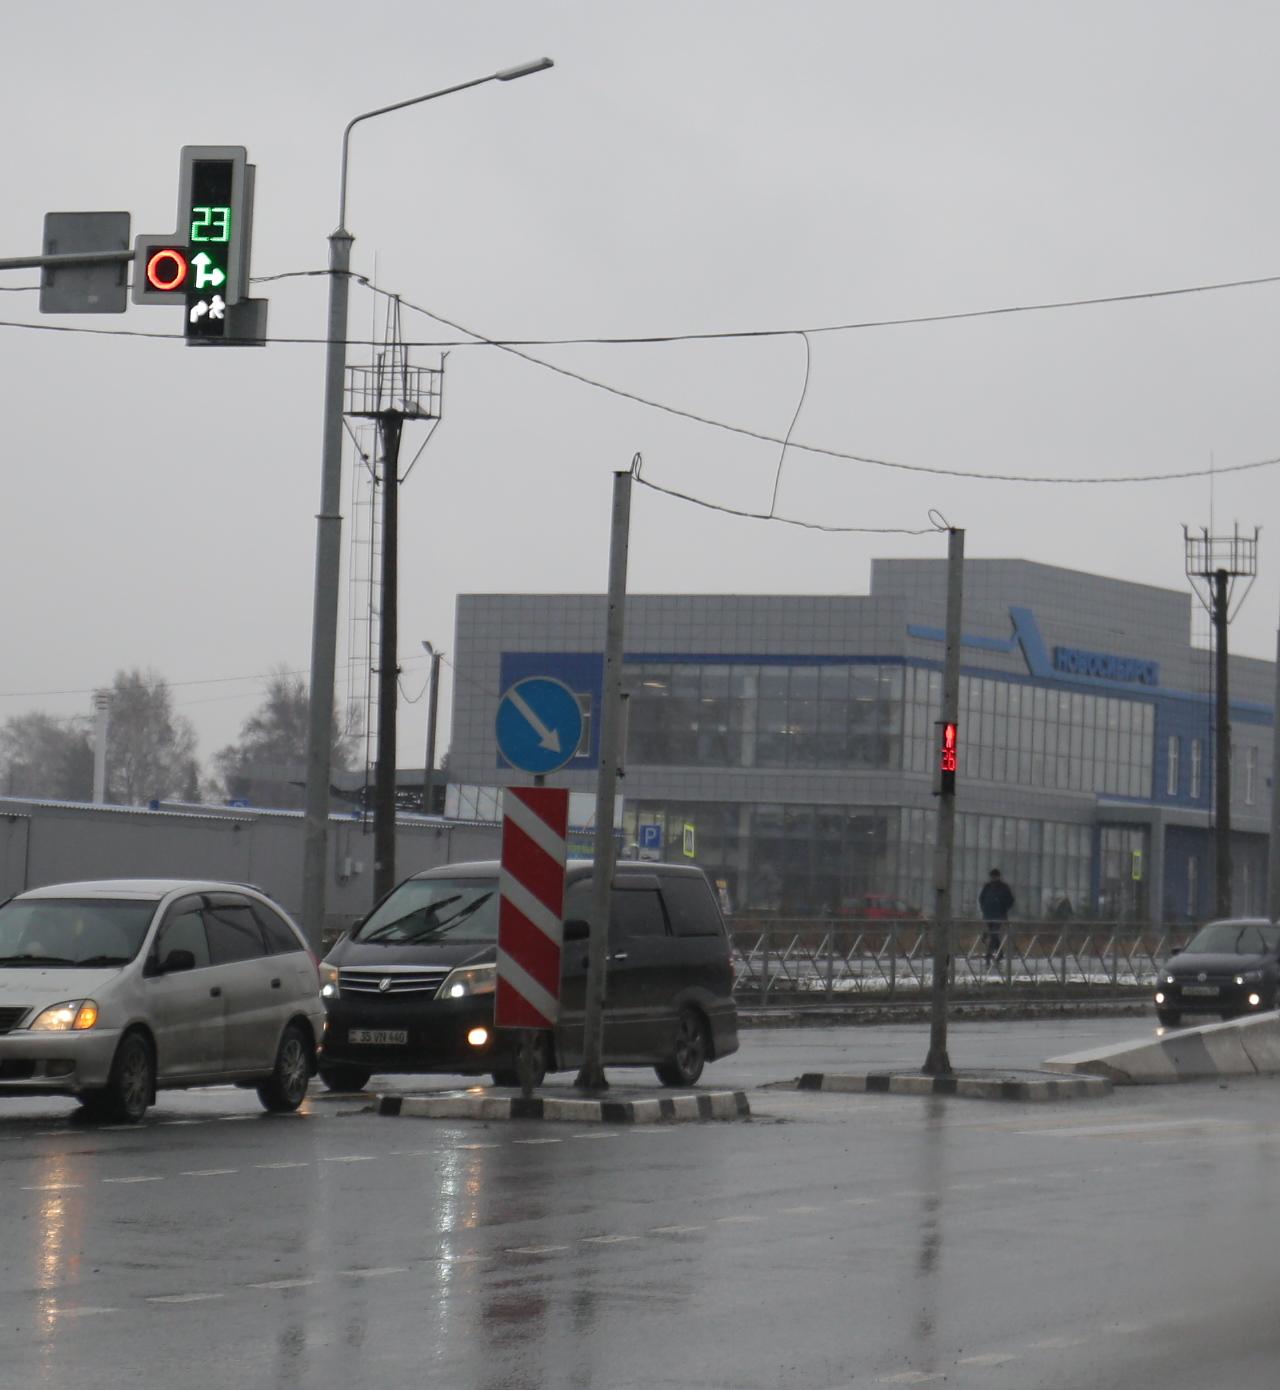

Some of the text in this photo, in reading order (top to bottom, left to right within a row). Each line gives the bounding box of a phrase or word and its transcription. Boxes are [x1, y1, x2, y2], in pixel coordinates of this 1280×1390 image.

[192, 207, 230, 242] 23
[1054, 646, 1160, 686] НОВОСИБИРСК
[942, 750, 955, 771] 26
[645, 828, 657, 845] P
